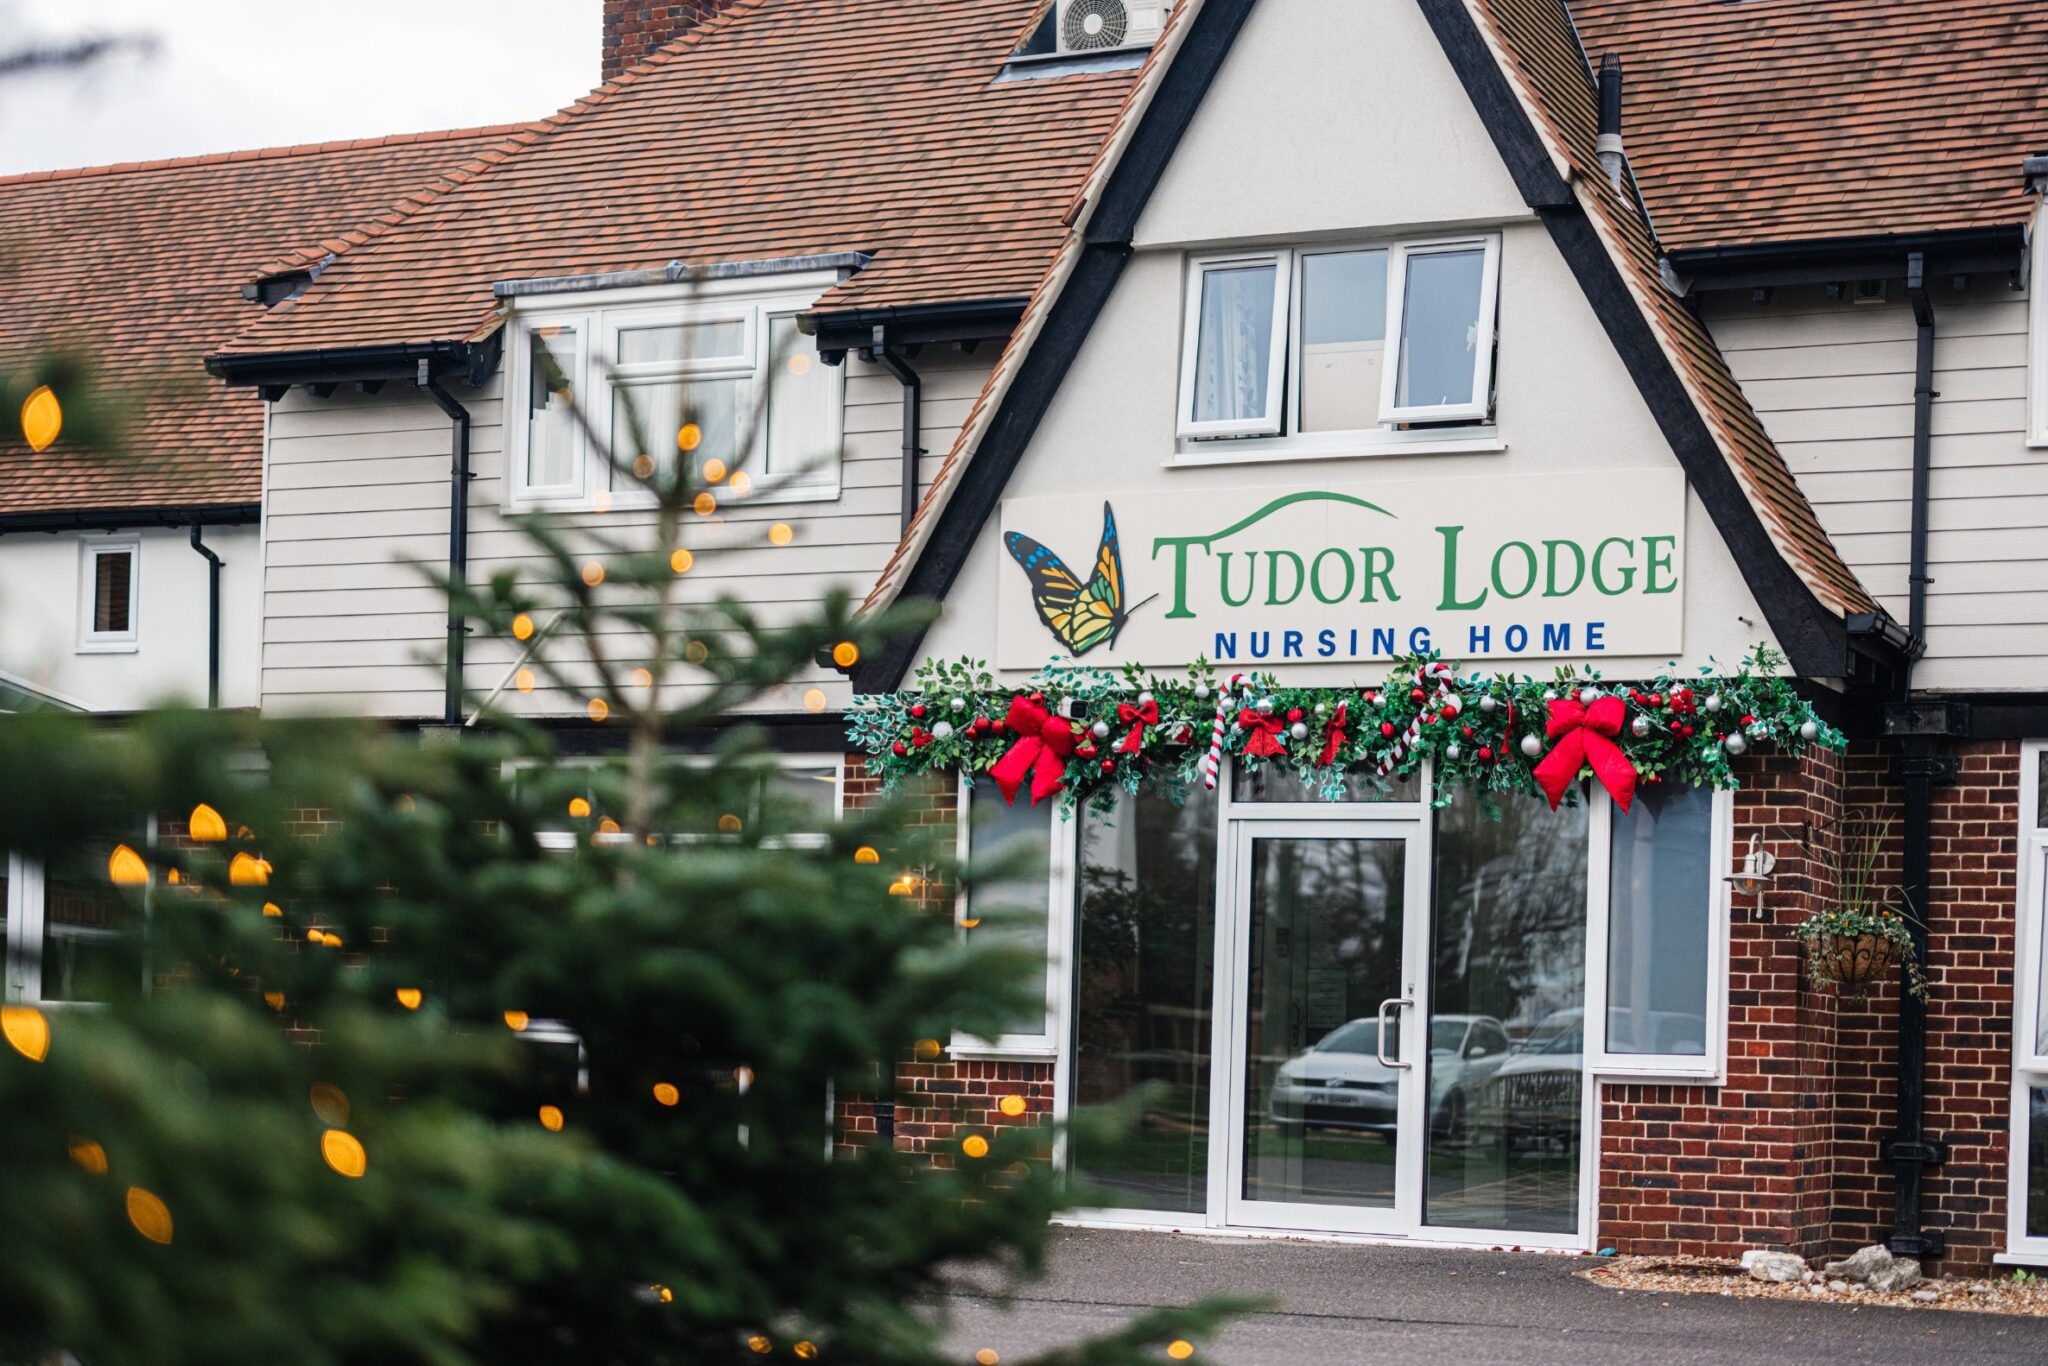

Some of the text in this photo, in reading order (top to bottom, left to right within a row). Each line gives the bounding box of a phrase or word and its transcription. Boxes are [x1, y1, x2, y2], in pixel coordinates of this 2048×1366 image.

[1151, 525, 1677, 619] TUDOR LODGE
[1214, 622, 1605, 660] NURSING HOME
